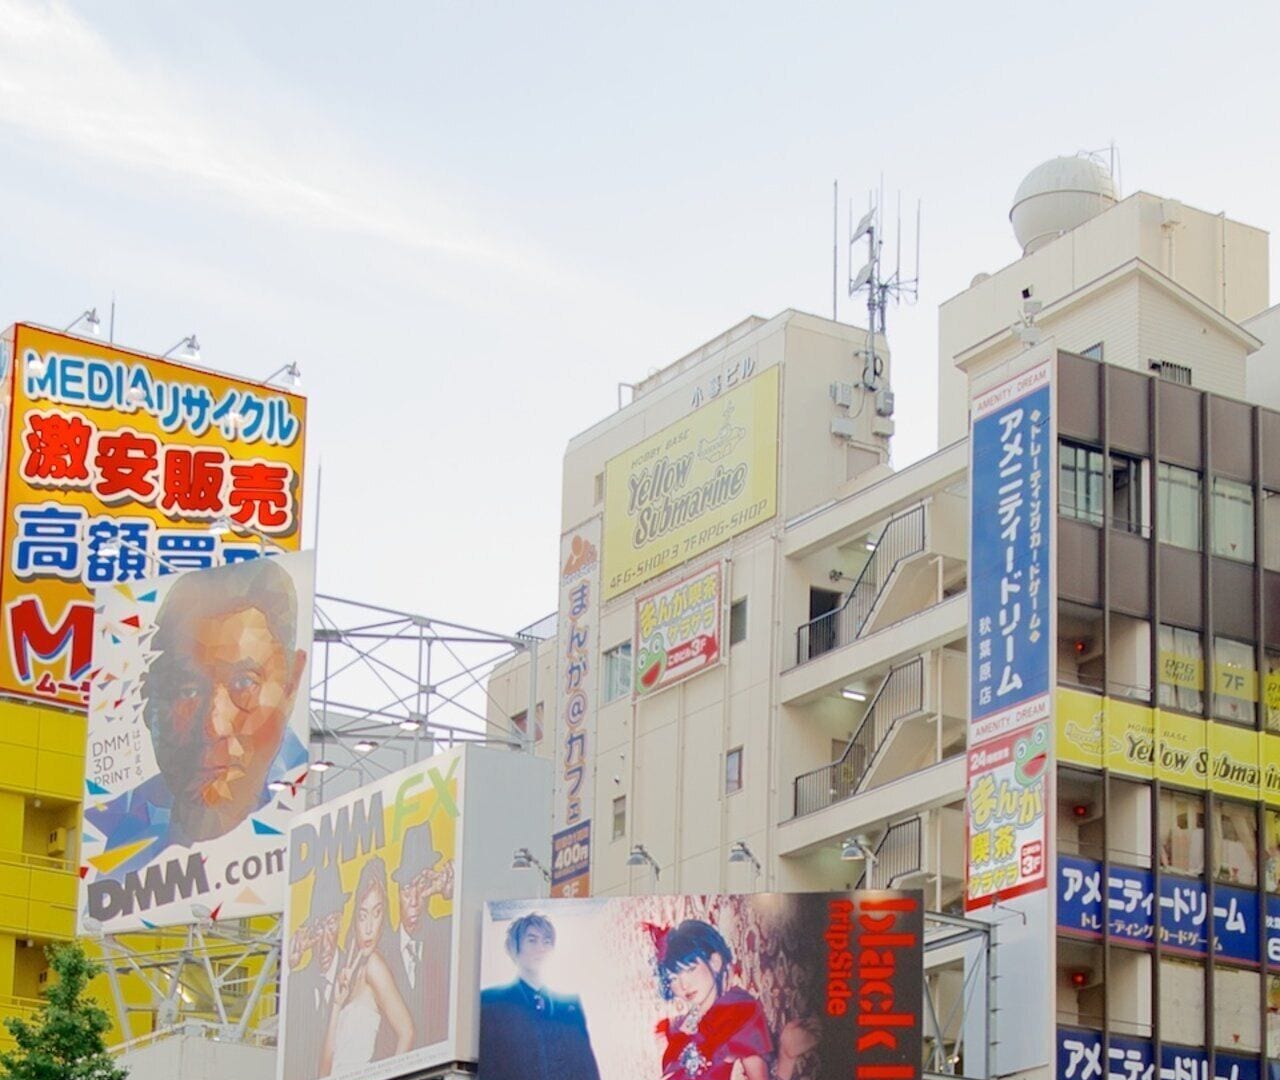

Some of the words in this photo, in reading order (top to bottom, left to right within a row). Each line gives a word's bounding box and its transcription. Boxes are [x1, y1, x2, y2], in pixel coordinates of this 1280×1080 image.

[25, 354, 295, 441] MEDIAリサイクル
[976, 385, 1012, 411] AMENITY
[1016, 369, 1047, 393] DREAM
[25, 414, 289, 528] 激安販売
[628, 454, 695, 514] Yellow
[635, 463, 747, 548] Submarine
[998, 408, 1024, 697] アメニティードリーム
[979, 616, 991, 706] 秋葉原店
[1221, 672, 1244, 691] 7F
[93, 732, 129, 757] DMM
[976, 716, 1010, 738] AMENITY
[1015, 702, 1046, 723] DREAM
[94, 755, 114, 775] 3D
[94, 766, 131, 786] PRINT
[1128, 735, 1189, 770] Yellow
[289, 791, 385, 886] DMM
[391, 756, 462, 842] FX
[971, 775, 1045, 827] まんが
[971, 824, 1015, 864] 喫茶
[88, 846, 288, 924] DMM.com
[1061, 867, 1246, 934] アメニティードリーム
[823, 897, 854, 1017] fripSide
[855, 897, 917, 1051] black
